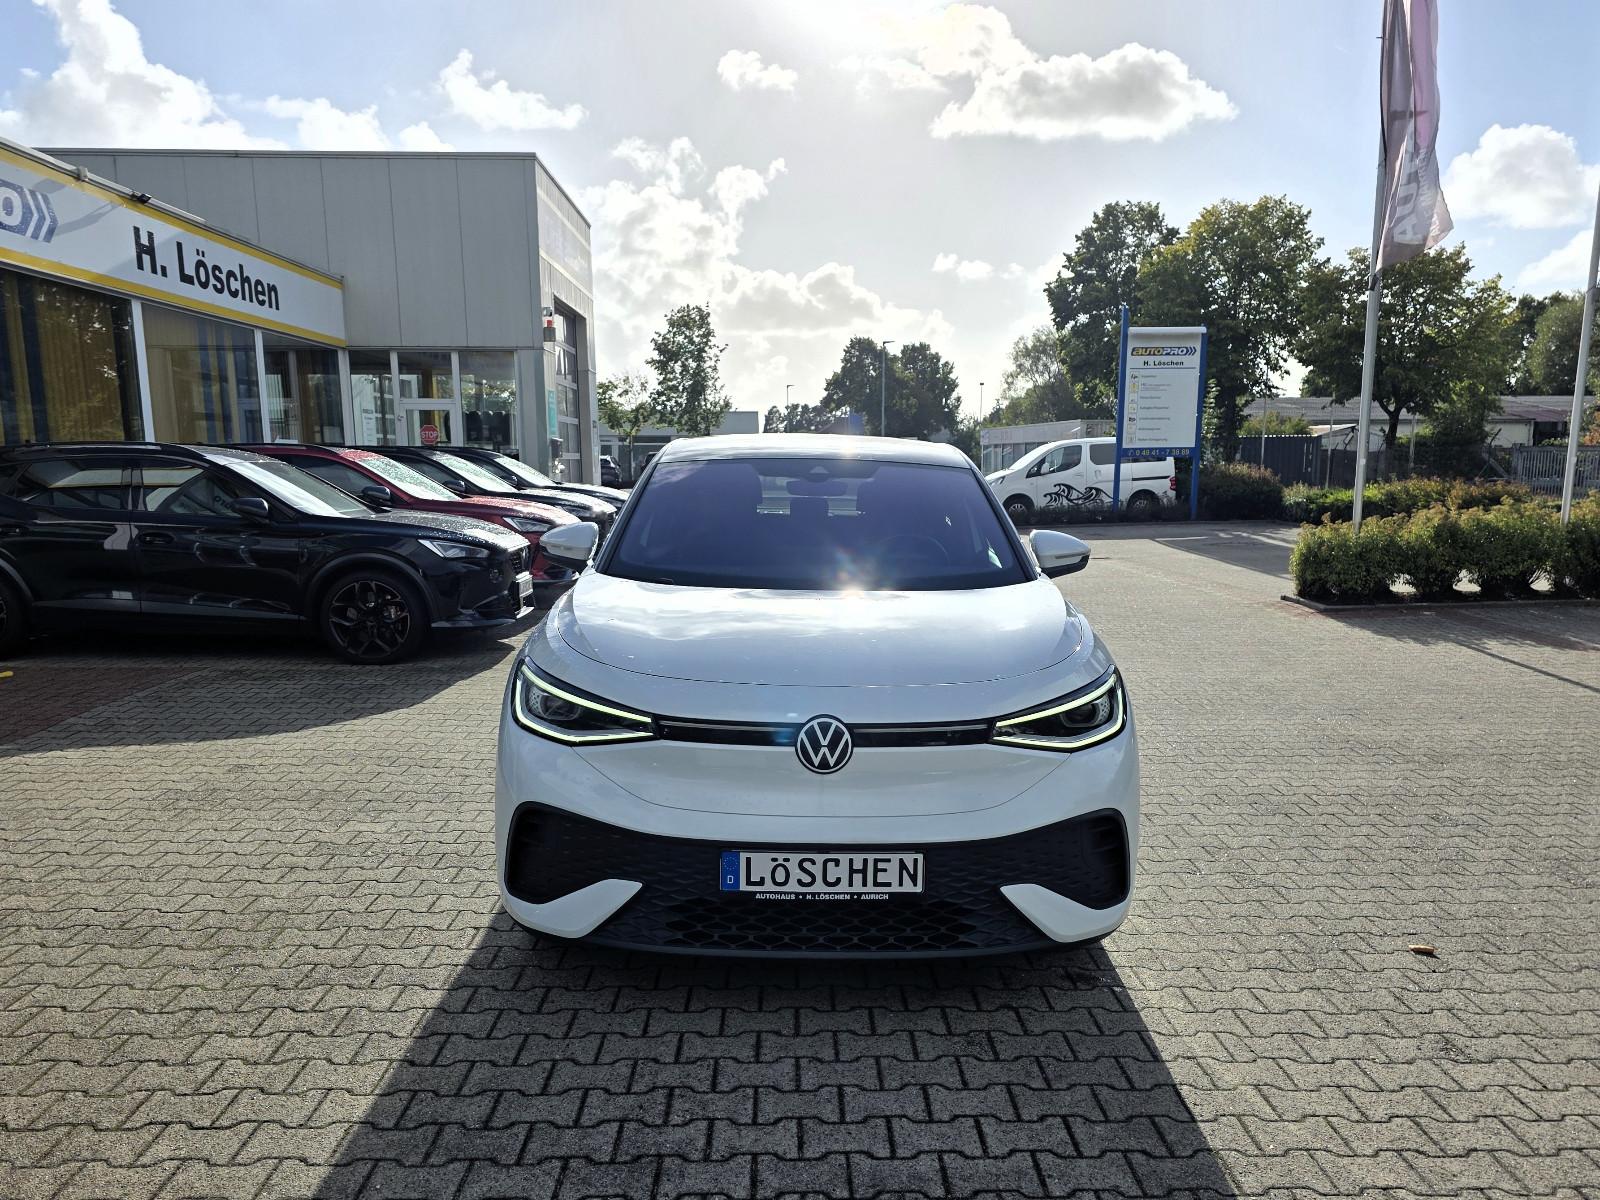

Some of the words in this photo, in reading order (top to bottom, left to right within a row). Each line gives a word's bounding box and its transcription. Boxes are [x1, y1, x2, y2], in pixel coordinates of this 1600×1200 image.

[132, 225, 168, 278] H.
[175, 240, 281, 311] Löschen
[420, 431, 438, 440] STOP
[745, 856, 918, 888] LÖSCHEN
[727, 875, 734, 884] D
[755, 892, 796, 900] AUTOHAUS
[815, 892, 851, 900] LÖSCHEN
